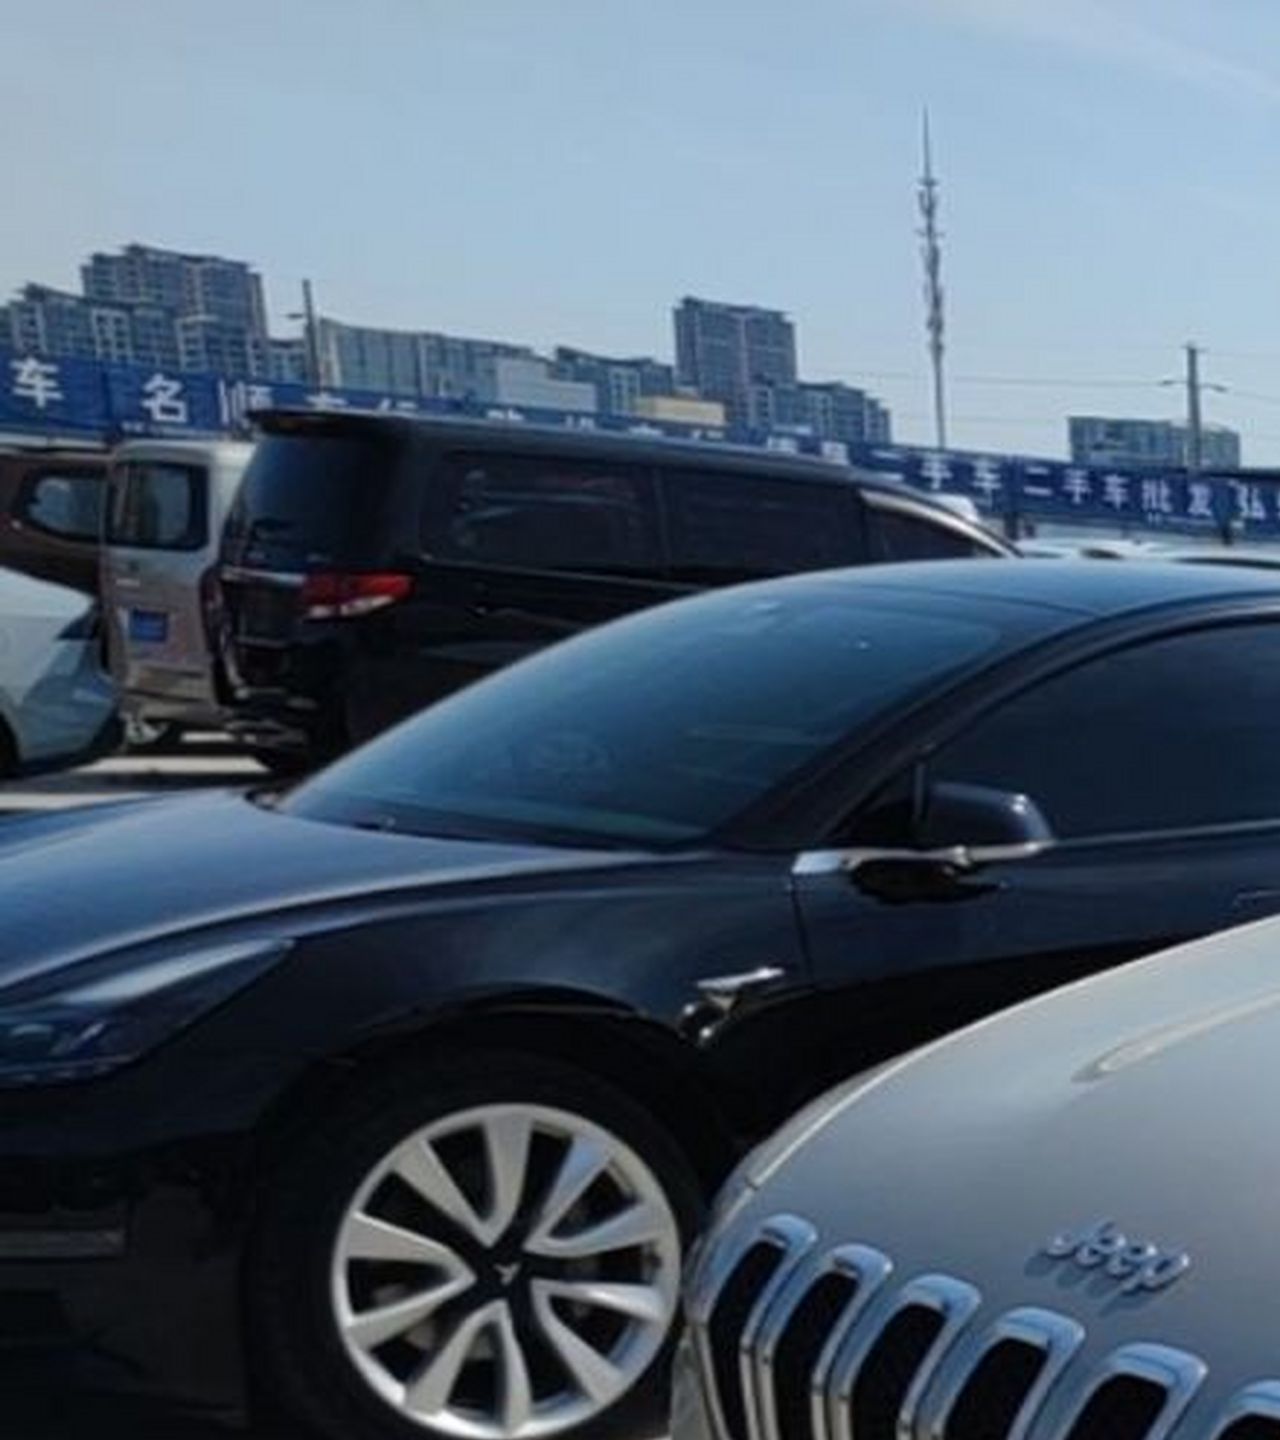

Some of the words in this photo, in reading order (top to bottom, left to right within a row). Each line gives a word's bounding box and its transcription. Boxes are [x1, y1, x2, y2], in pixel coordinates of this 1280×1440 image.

[1023, 466, 1213, 518] 二手车批发
[1045, 1218, 1192, 1296] Jeep
